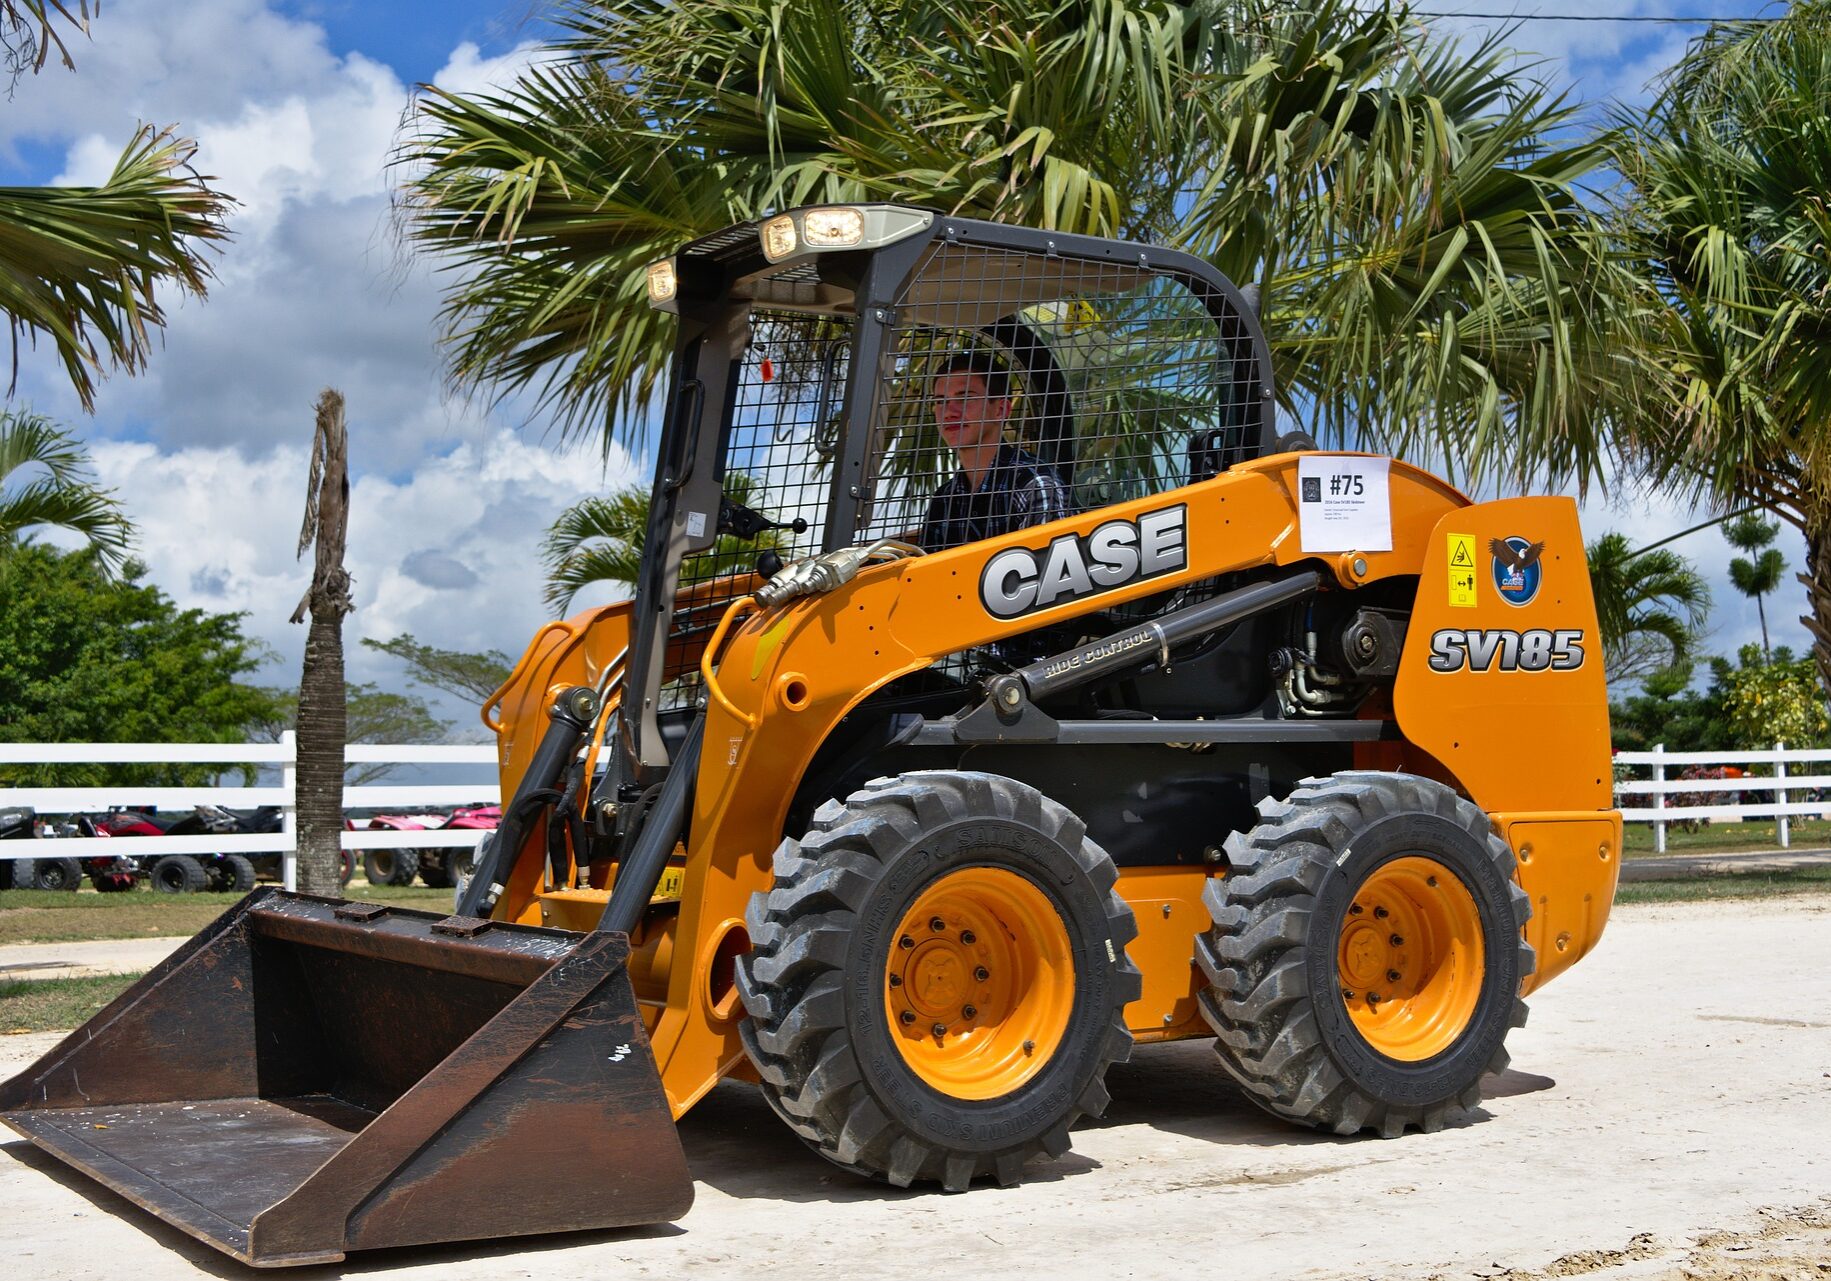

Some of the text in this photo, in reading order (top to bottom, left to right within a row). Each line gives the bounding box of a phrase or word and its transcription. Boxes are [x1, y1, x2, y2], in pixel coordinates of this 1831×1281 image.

[1330, 474, 1364, 496] #75
[980, 503, 1188, 619] CASE
[1502, 577, 1524, 586] CASE
[1043, 631, 1153, 679] RIDE CONTROL
[1429, 627, 1586, 674] SV185
[957, 827, 1058, 866] SAMSON
[975, 1081, 1073, 1143] PREMIUM
